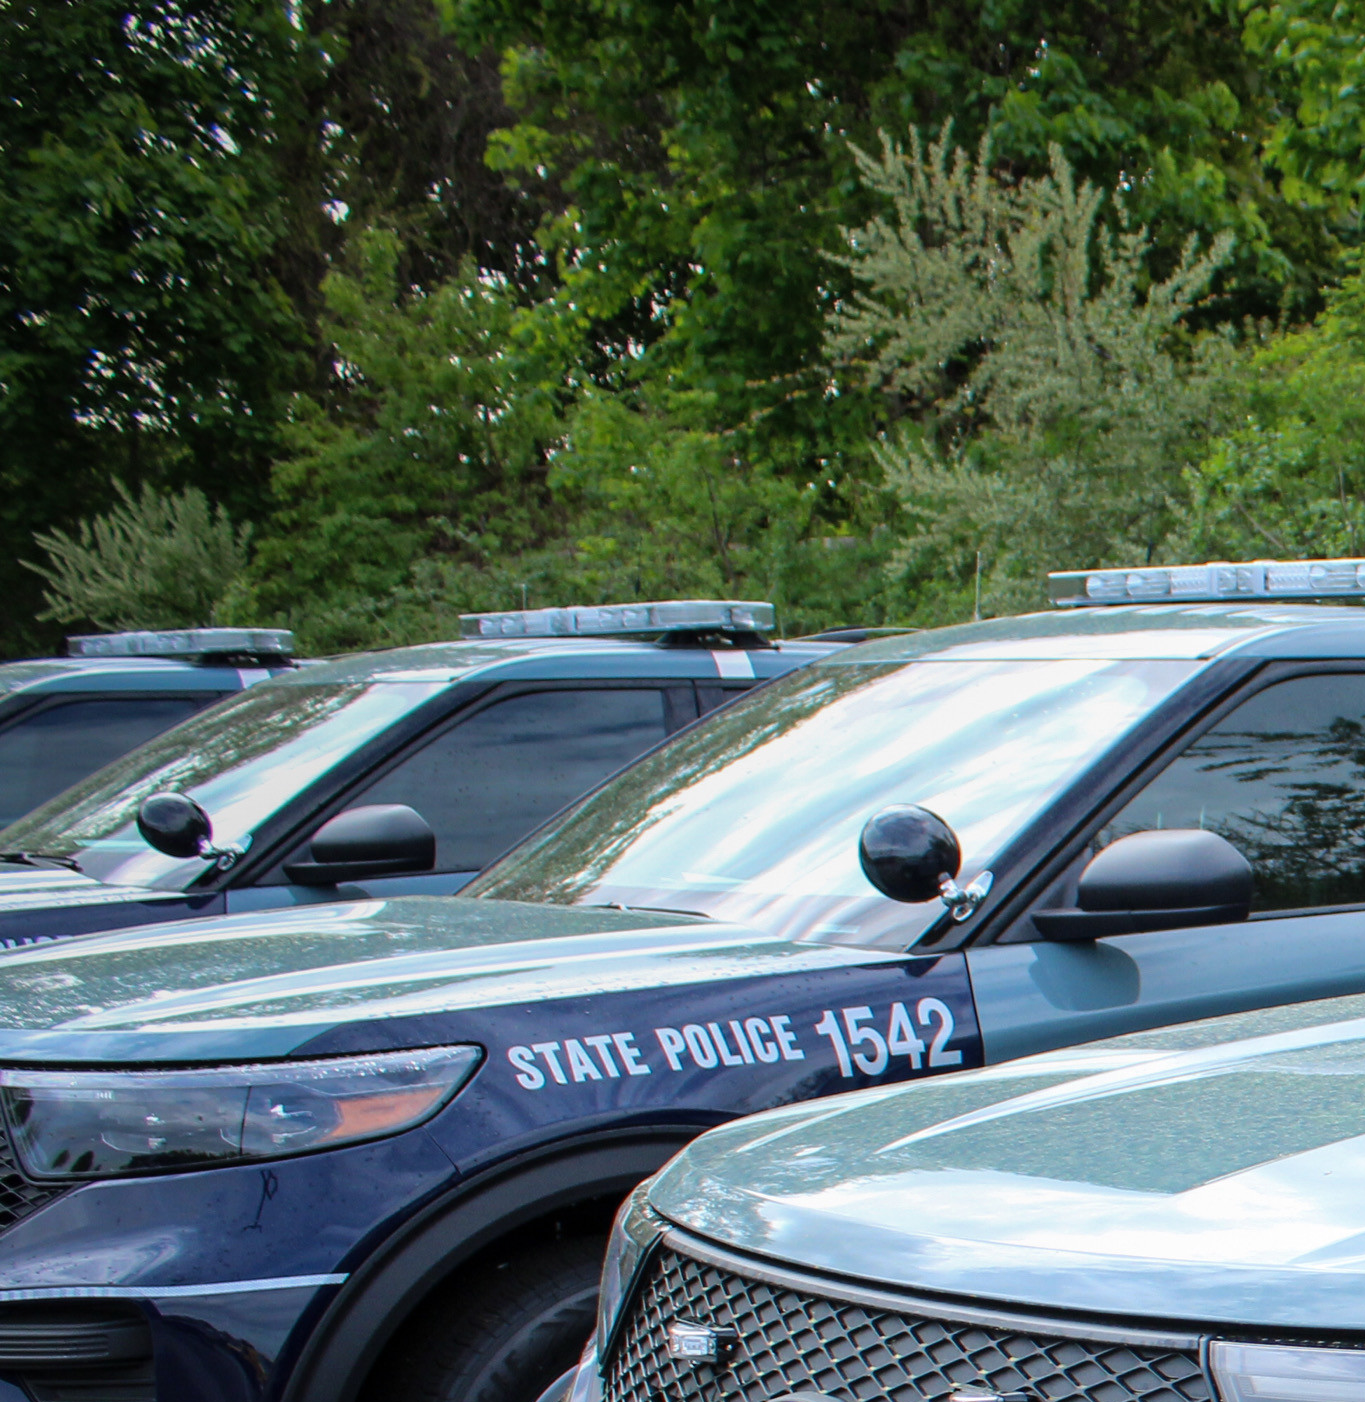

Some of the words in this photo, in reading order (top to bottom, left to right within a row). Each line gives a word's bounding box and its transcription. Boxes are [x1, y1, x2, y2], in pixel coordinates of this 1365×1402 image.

[507, 1031, 652, 1091] STATE
[654, 1014, 804, 1072] POLICE
[814, 996, 963, 1079] 1542
